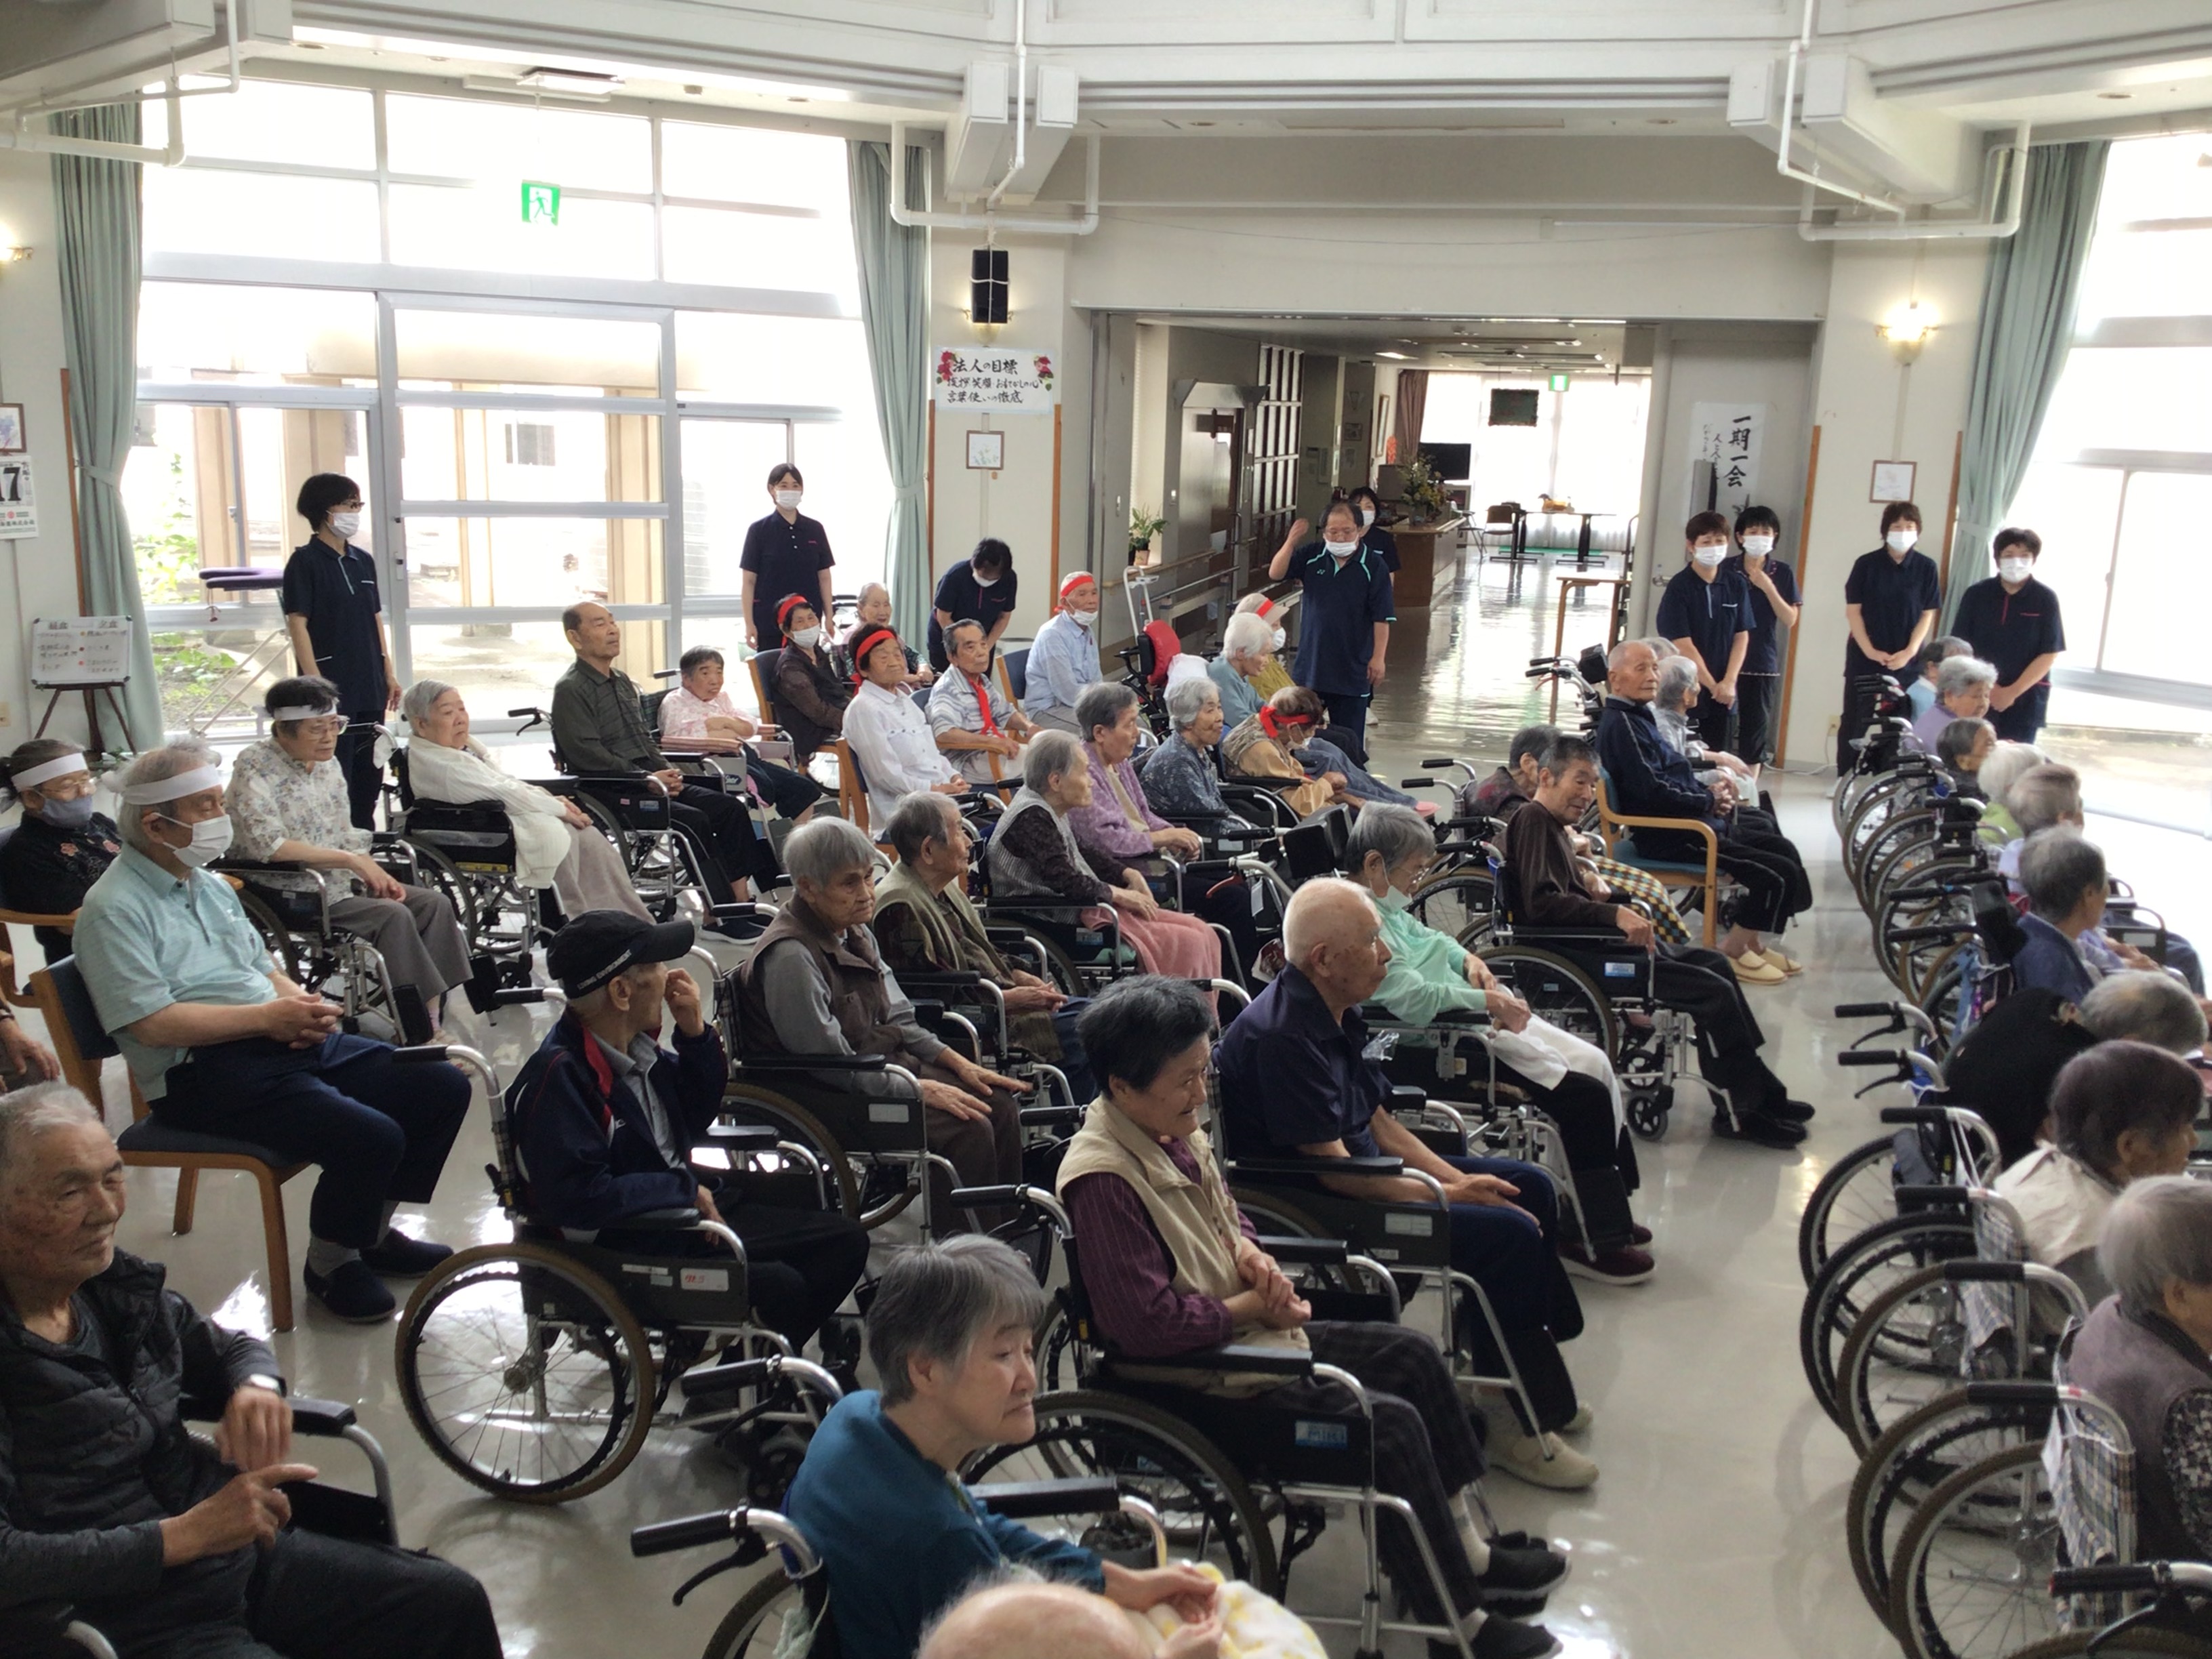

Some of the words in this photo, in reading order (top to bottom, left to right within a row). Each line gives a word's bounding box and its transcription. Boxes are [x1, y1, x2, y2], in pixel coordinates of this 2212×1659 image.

[953, 358, 1018, 375] 法人の目標
[1723, 415, 1751, 487] 一期一会
